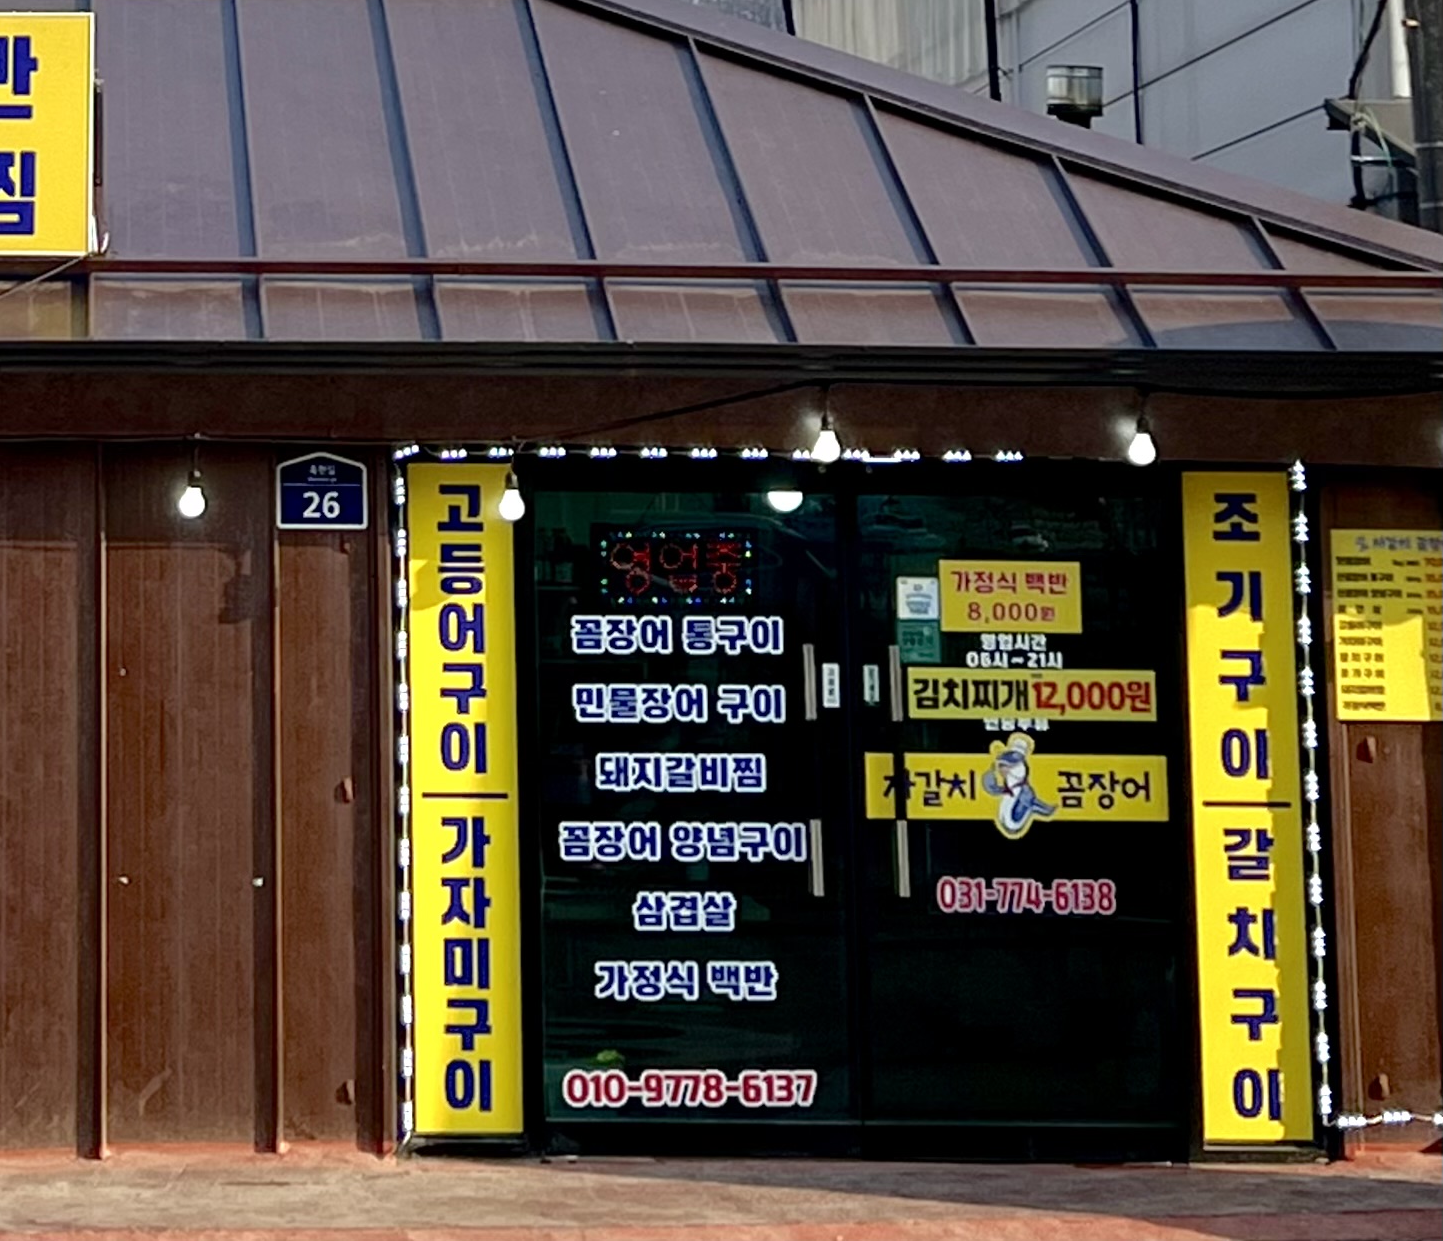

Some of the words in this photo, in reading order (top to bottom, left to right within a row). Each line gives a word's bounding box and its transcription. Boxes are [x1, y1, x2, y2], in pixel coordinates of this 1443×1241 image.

[302, 490, 341, 519] 26
[951, 571, 1018, 594] 가정식
[1025, 572, 1069, 595] 백반
[437, 483, 488, 775] 고등어구이
[571, 615, 673, 655] 꼼장어
[682, 616, 784, 655] 통구이
[980, 633, 1047, 652] 영업시간
[1212, 492, 1269, 780] 조기구이
[572, 683, 708, 723] 민물장어
[717, 684, 786, 724] 구이
[913, 678, 1030, 712] 김치찌개
[1032, 680, 1153, 716] 12,000원
[595, 752, 767, 793] 돼지갈비찜
[1057, 770, 1152, 810] 꼼장어
[559, 821, 661, 861] 꼼장어
[669, 822, 807, 862] 양념구이
[632, 891, 738, 932] 삼겹살
[937, 875, 1117, 915] 031-774-6138
[440, 816, 492, 1112] 가자미구이
[594, 961, 699, 1001] 가정식
[707, 961, 779, 1001] 백반
[1223, 828, 1282, 1121] 갈치구이
[562, 1068, 818, 1108] 010-9778-6137
